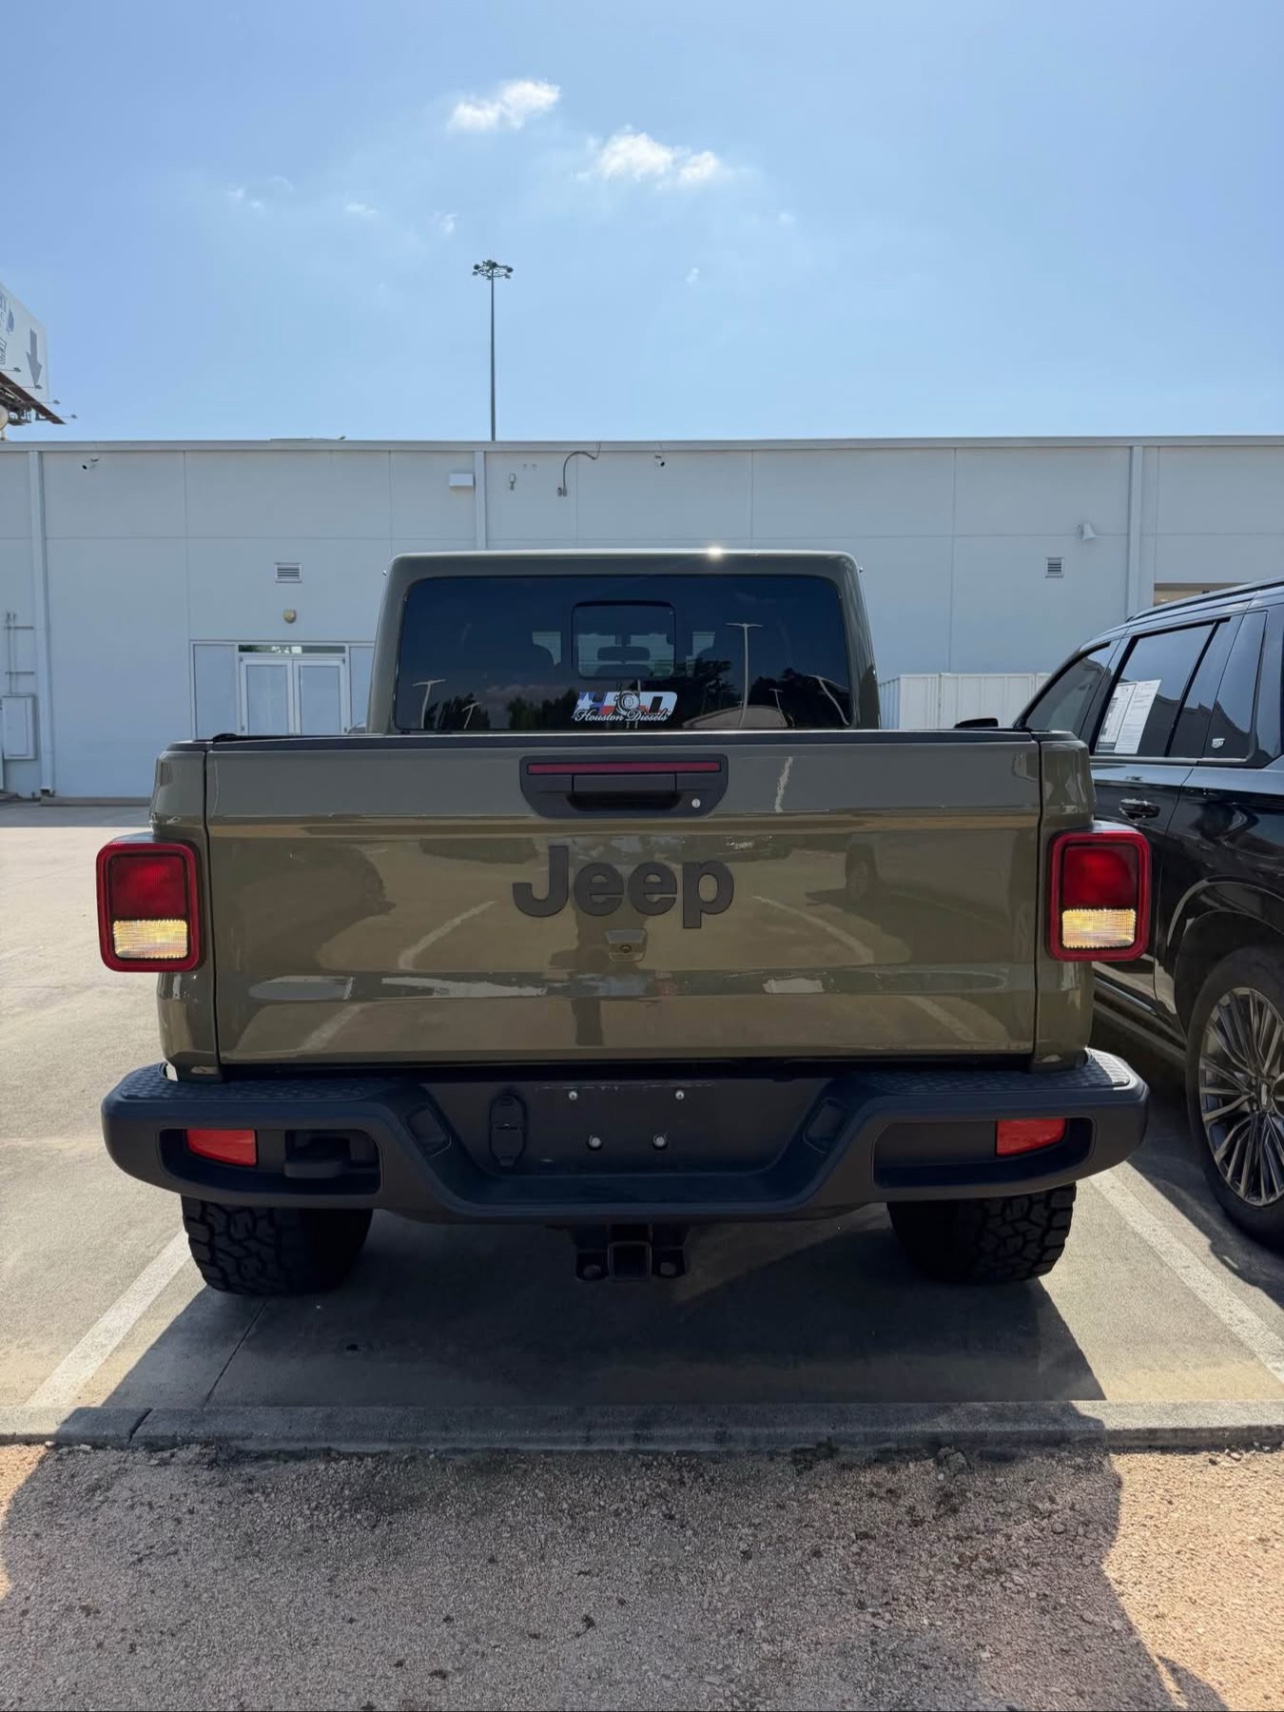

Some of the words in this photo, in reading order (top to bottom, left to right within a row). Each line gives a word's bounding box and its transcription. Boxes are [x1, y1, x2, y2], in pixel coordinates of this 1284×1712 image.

[574, 708, 624, 721] Houston
[624, 707, 669, 721] Diesels
[512, 845, 734, 929] Jeep
